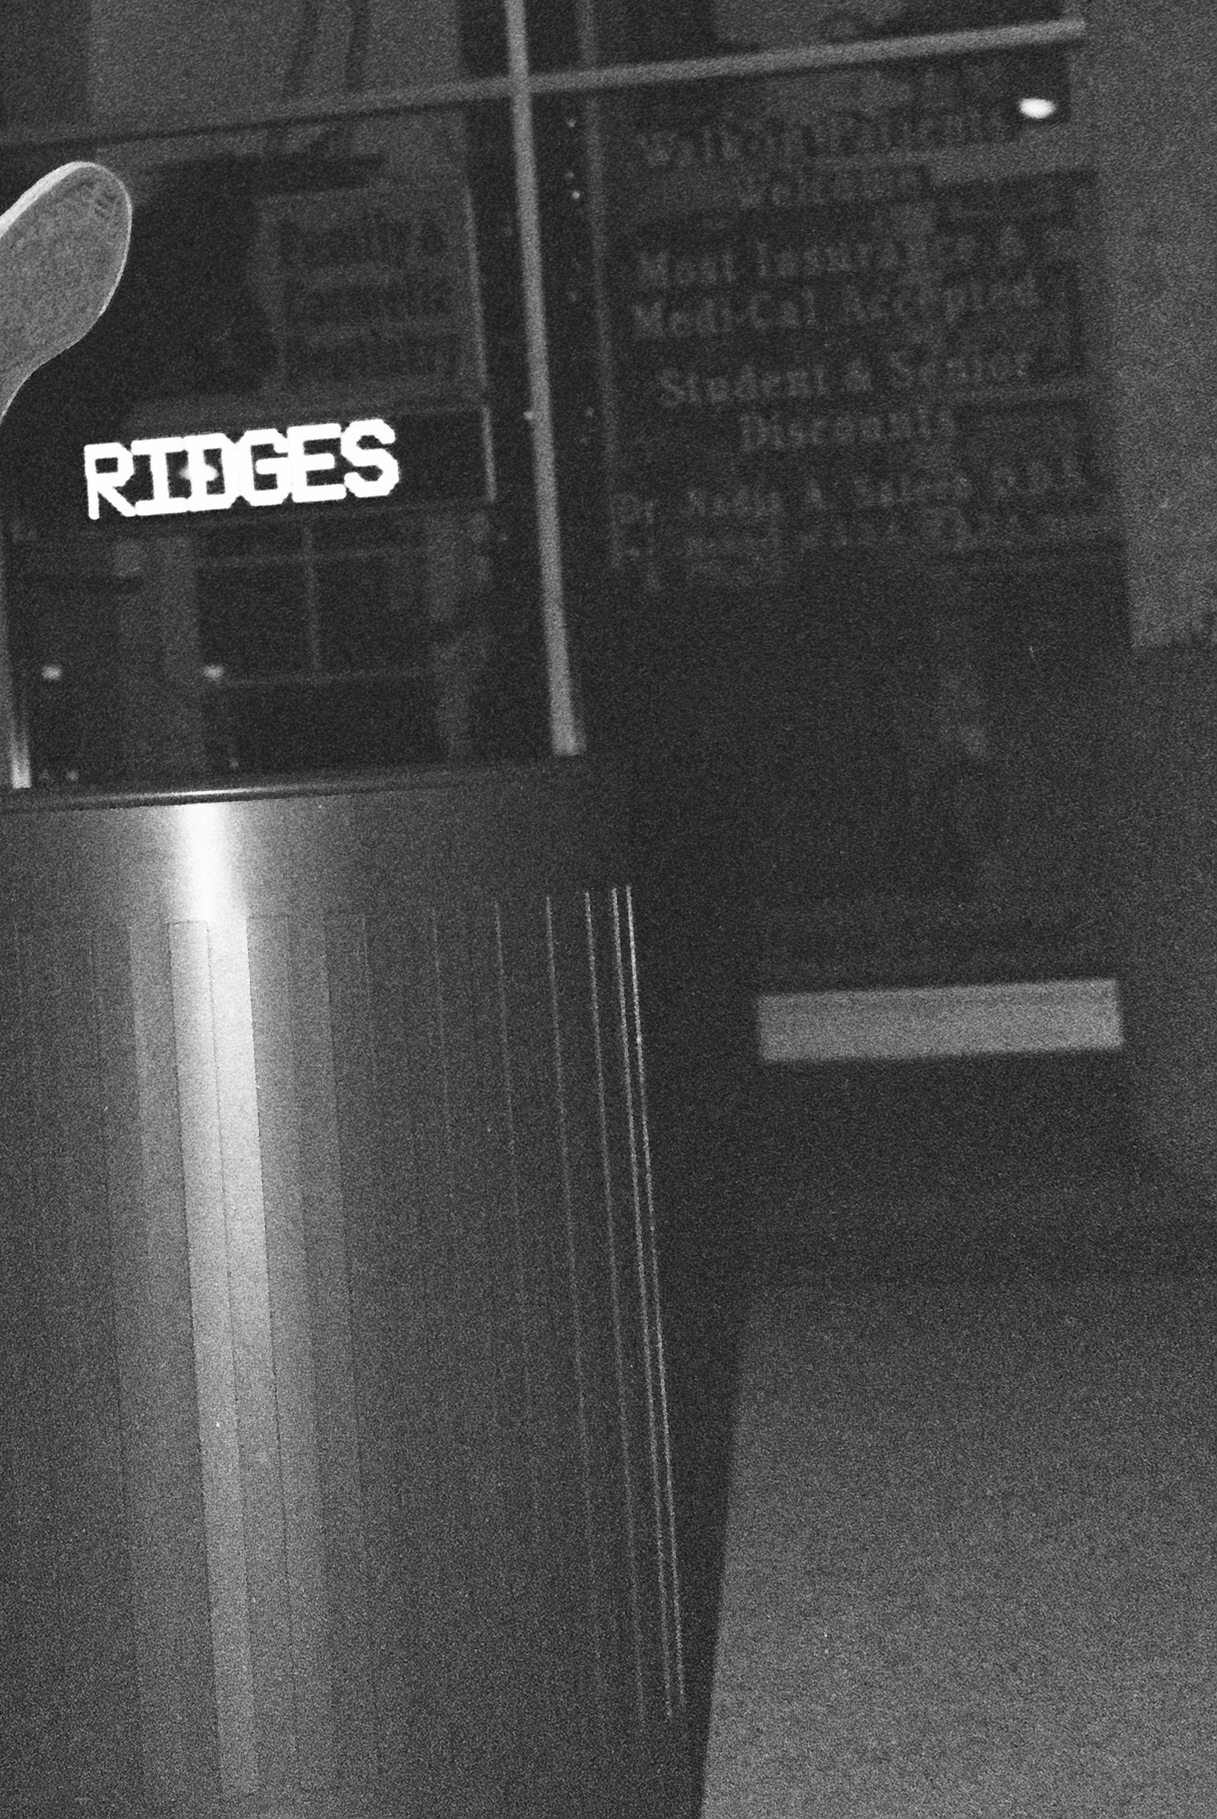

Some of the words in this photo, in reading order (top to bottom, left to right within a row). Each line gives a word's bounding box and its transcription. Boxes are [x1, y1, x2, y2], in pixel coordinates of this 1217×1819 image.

[636, 247, 738, 289] Most
[657, 363, 831, 409] Student
[843, 357, 872, 393] &
[888, 350, 1031, 392] Senior
[738, 405, 957, 453] Discounts
[83, 418, 401, 520] RIDGES
